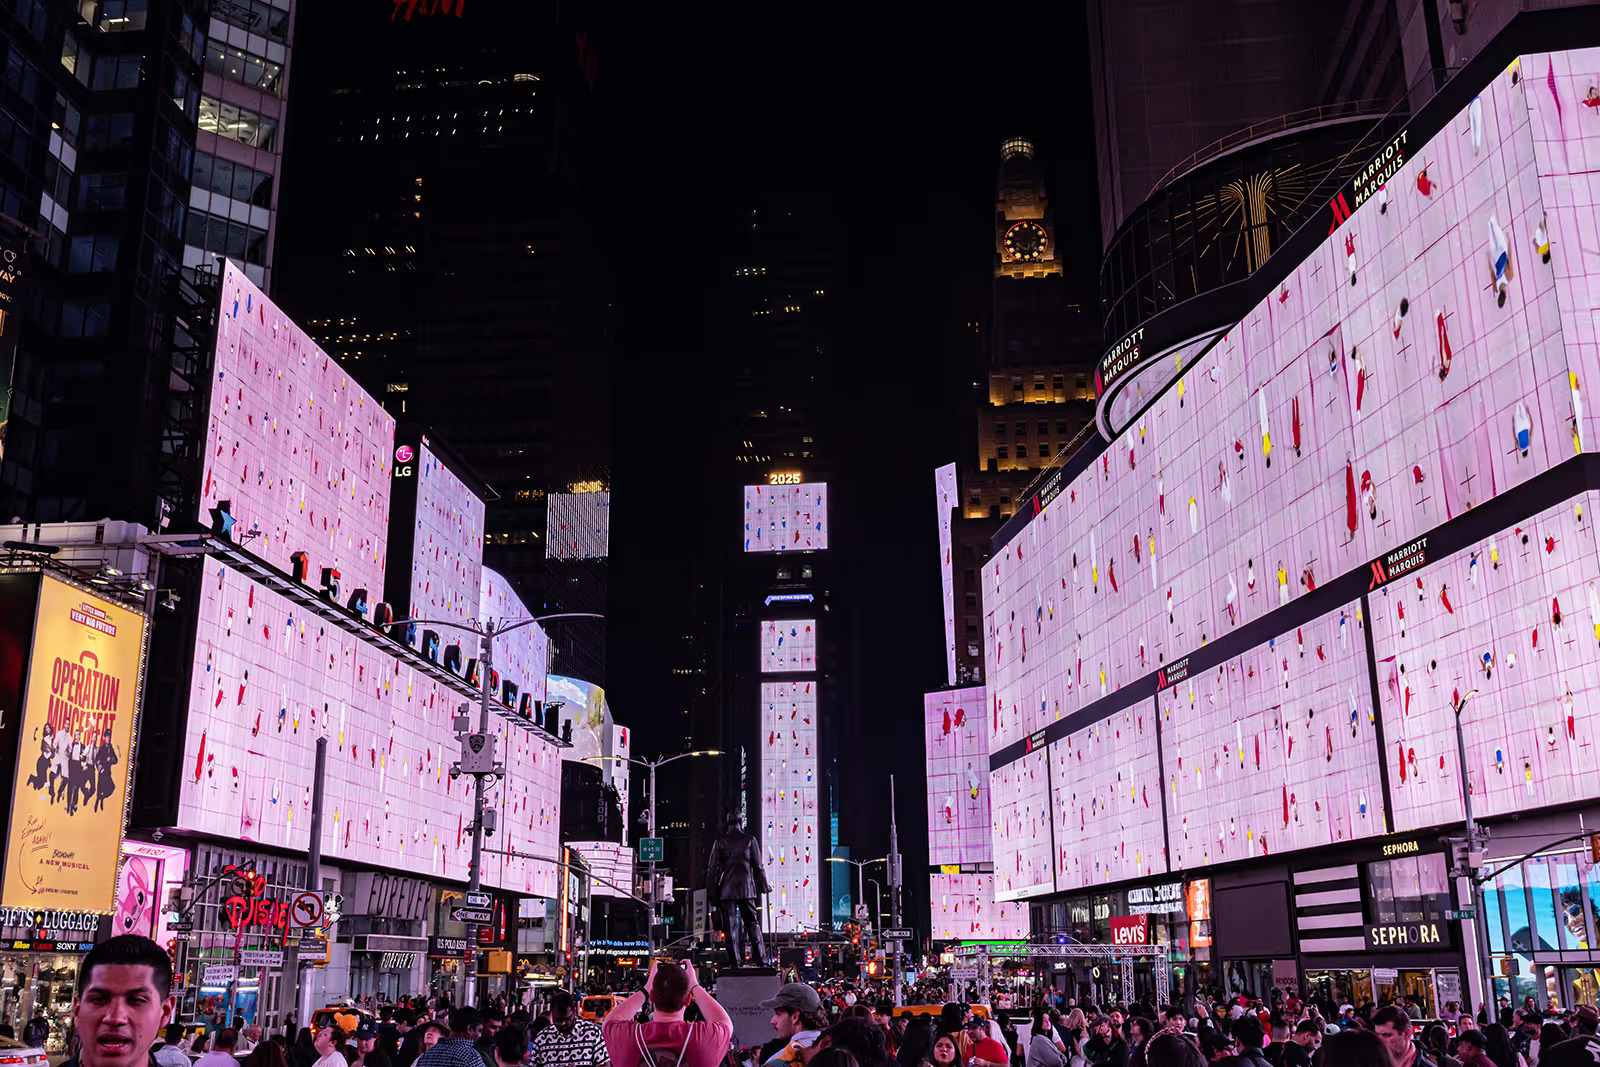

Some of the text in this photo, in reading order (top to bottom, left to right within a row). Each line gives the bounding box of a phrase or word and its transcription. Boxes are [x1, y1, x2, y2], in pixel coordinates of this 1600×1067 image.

[1353, 130, 1408, 191] MARRIOTT
[1355, 154, 1403, 207] MARQUIS
[1103, 328, 1144, 371] MARRIOTT
[1104, 347, 1139, 385] MARQUIS
[395, 466, 411, 477] LG
[770, 473, 801, 484] 2025
[1040, 472, 1062, 497] MARRIOTT
[1387, 537, 1427, 565] MARRIOTT
[1389, 553, 1425, 577] MARQUIS
[290, 551, 393, 633] 1540
[71, 610, 86, 623] VERY
[85, 616, 96, 627] BIG
[95, 620, 116, 636] FUTURE
[1167, 658, 1189, 674] MARRIOTT
[52, 657, 120, 711] OPERATION
[1383, 841, 1419, 856] SEPHORA
[62, 860, 89, 870] MUSICAL
[367, 873, 433, 921] FOREVER
[0, 909, 99, 931] GIFTS LUGGAGE
[456, 911, 468, 919] ONE
[13, 940, 31, 949] Nikon
[35, 929, 59, 940] I NY
[444, 939, 456, 949] POLO
[1372, 924, 1440, 946] SEPHORA
[56, 942, 77, 950] SONY
[381, 952, 409, 968] FOREVER
[1275, 977, 1297, 985] PANDORA
